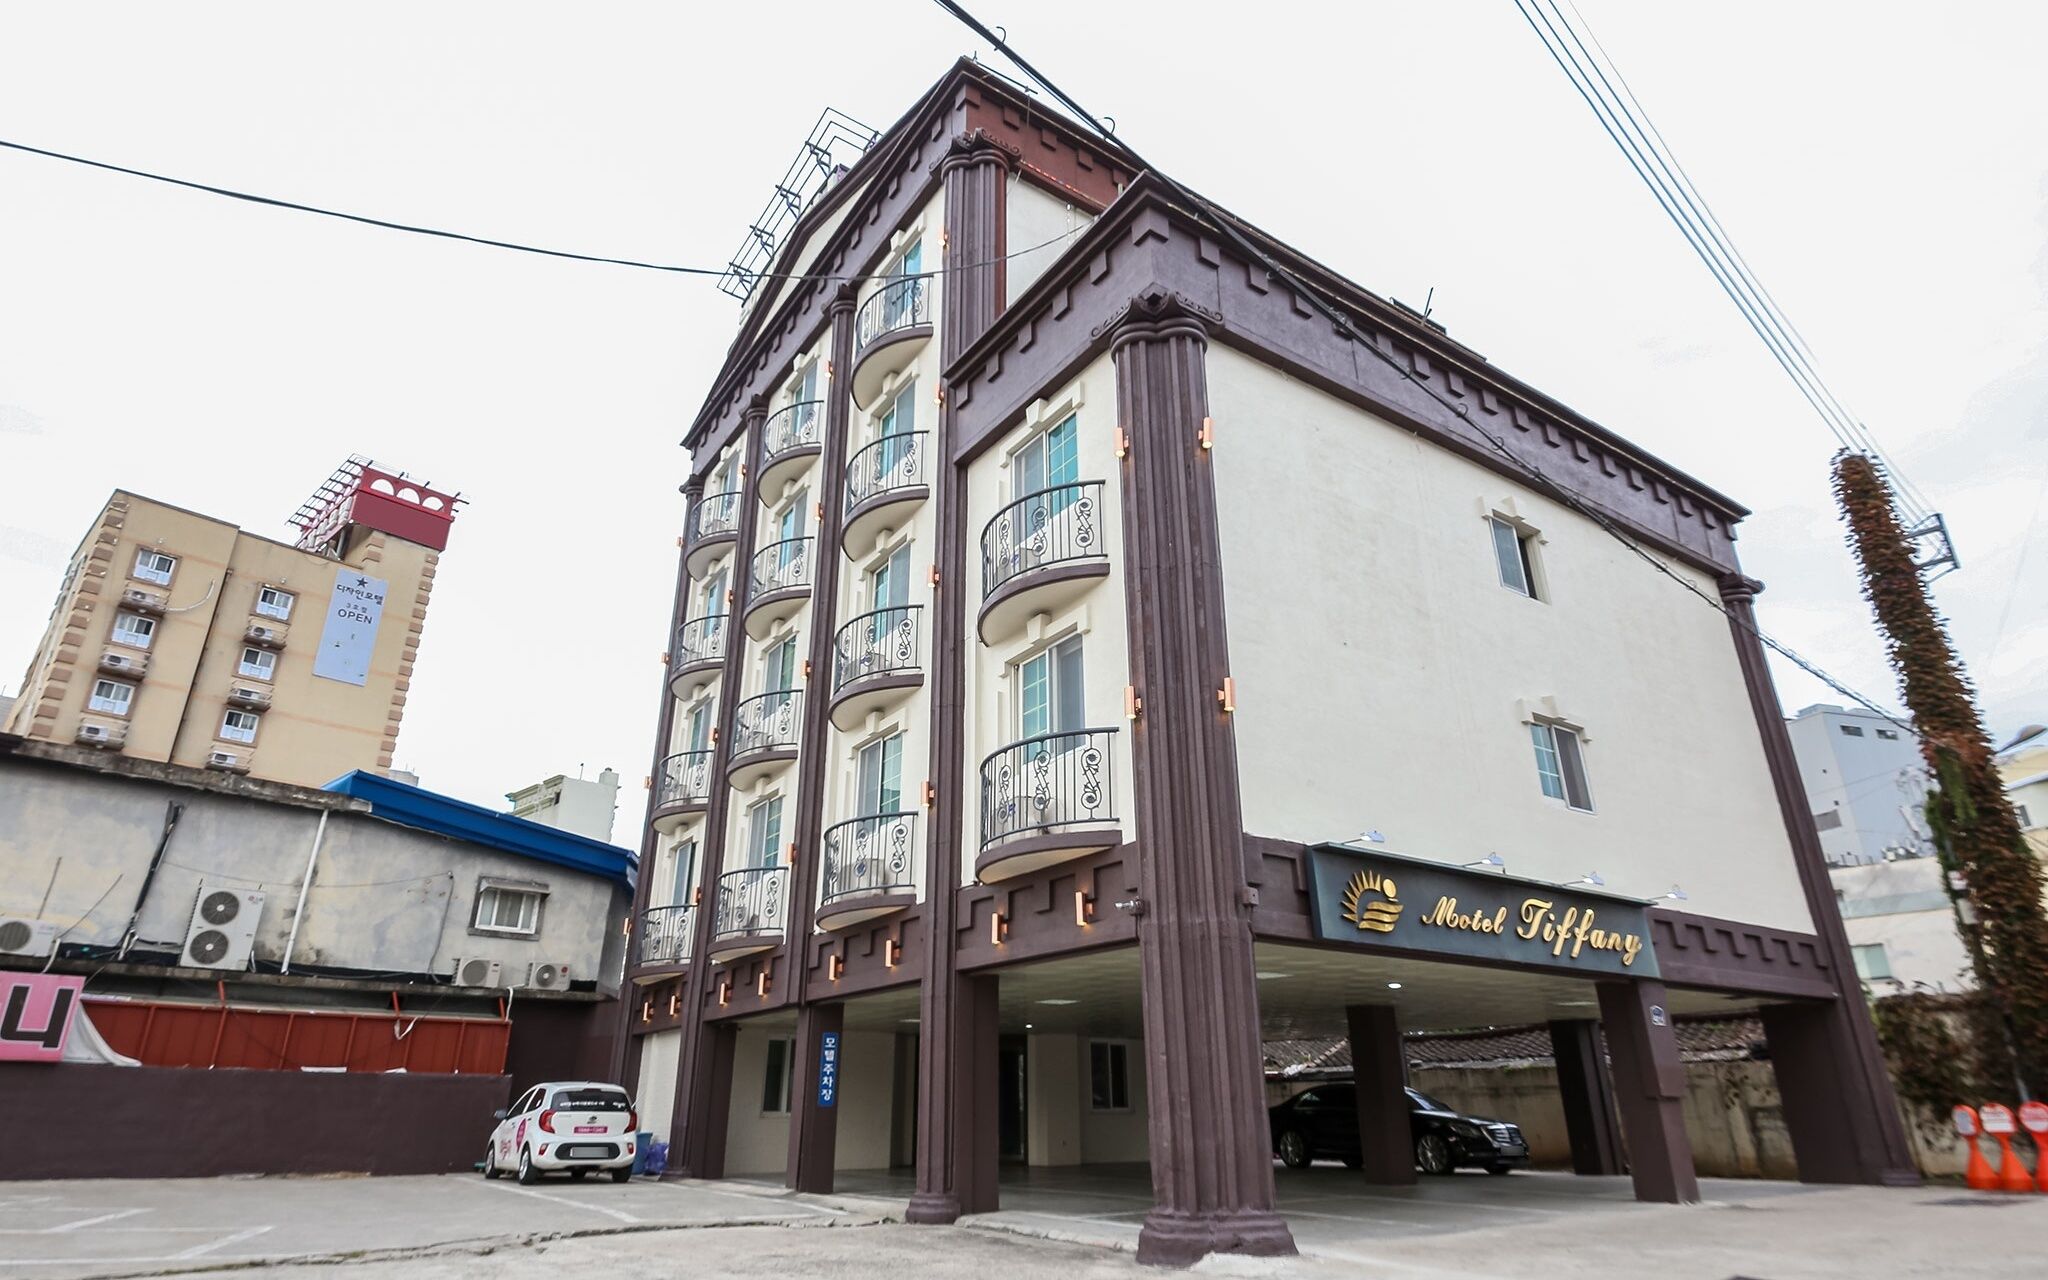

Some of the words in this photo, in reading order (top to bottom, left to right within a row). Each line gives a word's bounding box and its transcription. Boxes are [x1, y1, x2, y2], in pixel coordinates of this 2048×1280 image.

[338, 608, 373, 624] OPEN
[1420, 895, 1508, 935] Motel
[1517, 897, 1643, 967] Tiffany
[821, 1037, 836, 1101] 모텔주차장
